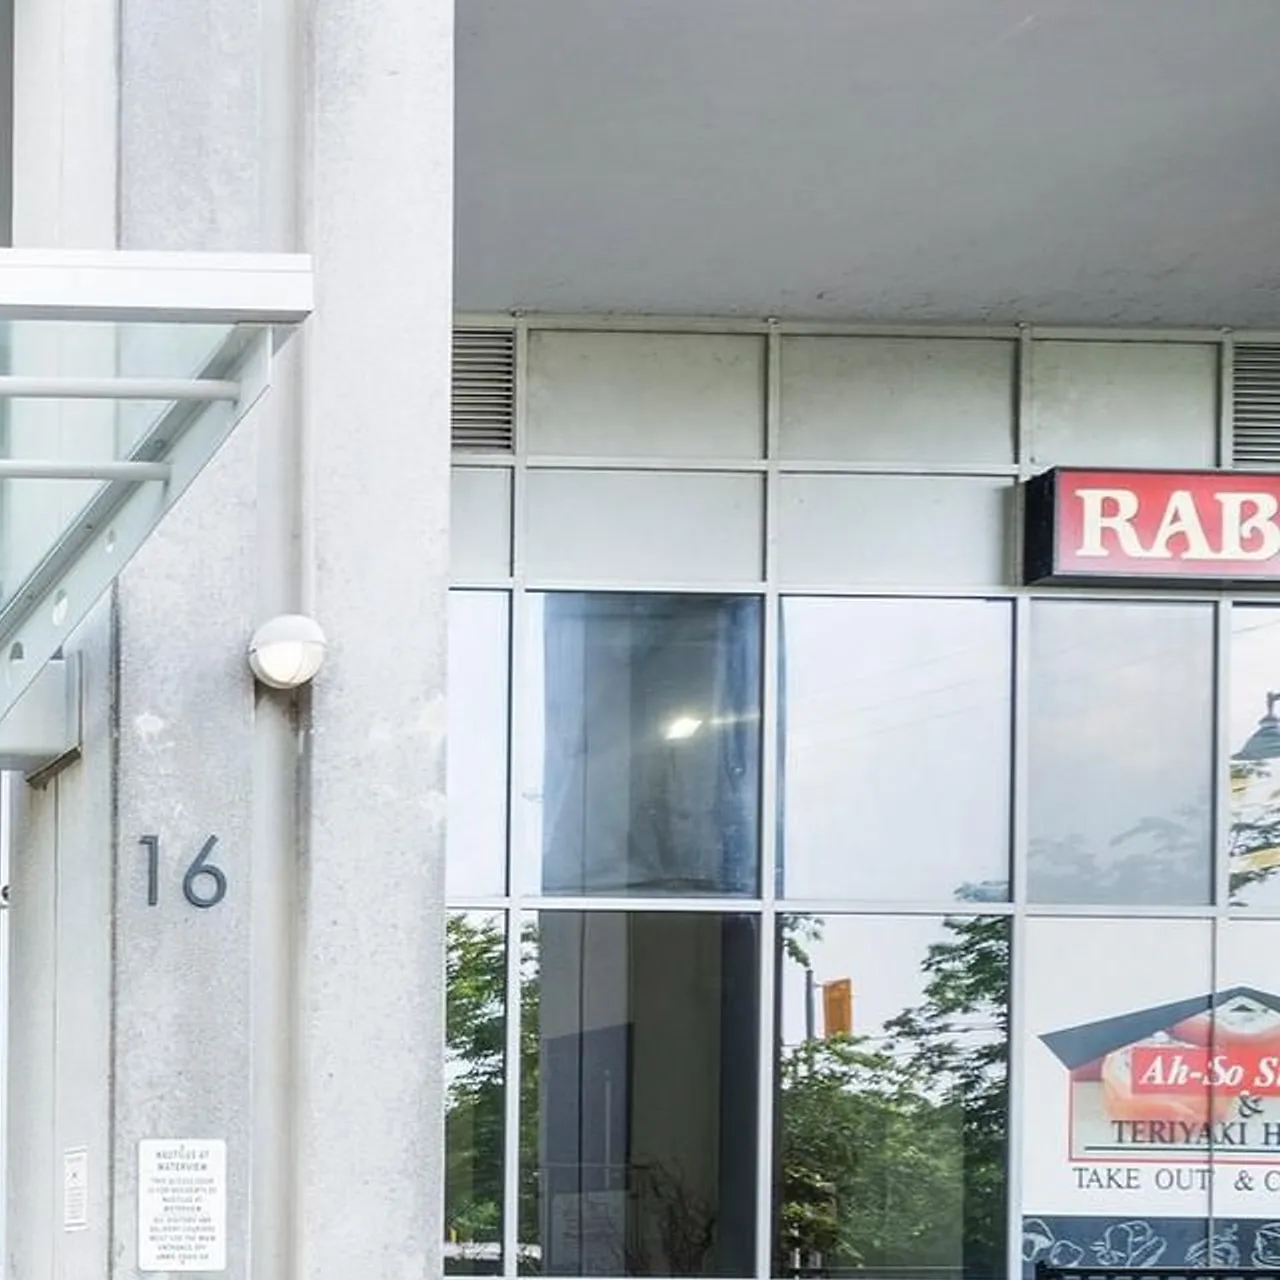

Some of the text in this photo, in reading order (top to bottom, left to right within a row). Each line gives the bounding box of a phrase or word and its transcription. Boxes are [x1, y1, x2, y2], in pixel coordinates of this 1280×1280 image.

[1074, 488, 1280, 561] RAB
[138, 834, 227, 909] 16
[1139, 1055, 1280, 1087] Ah-So S
[1238, 1093, 1265, 1119] &
[1111, 1120, 1247, 1145] TERIYAKI
[1072, 1168, 1140, 1189] TAKE
[1155, 1168, 1215, 1190] OUT
[1234, 1170, 1254, 1191] &
